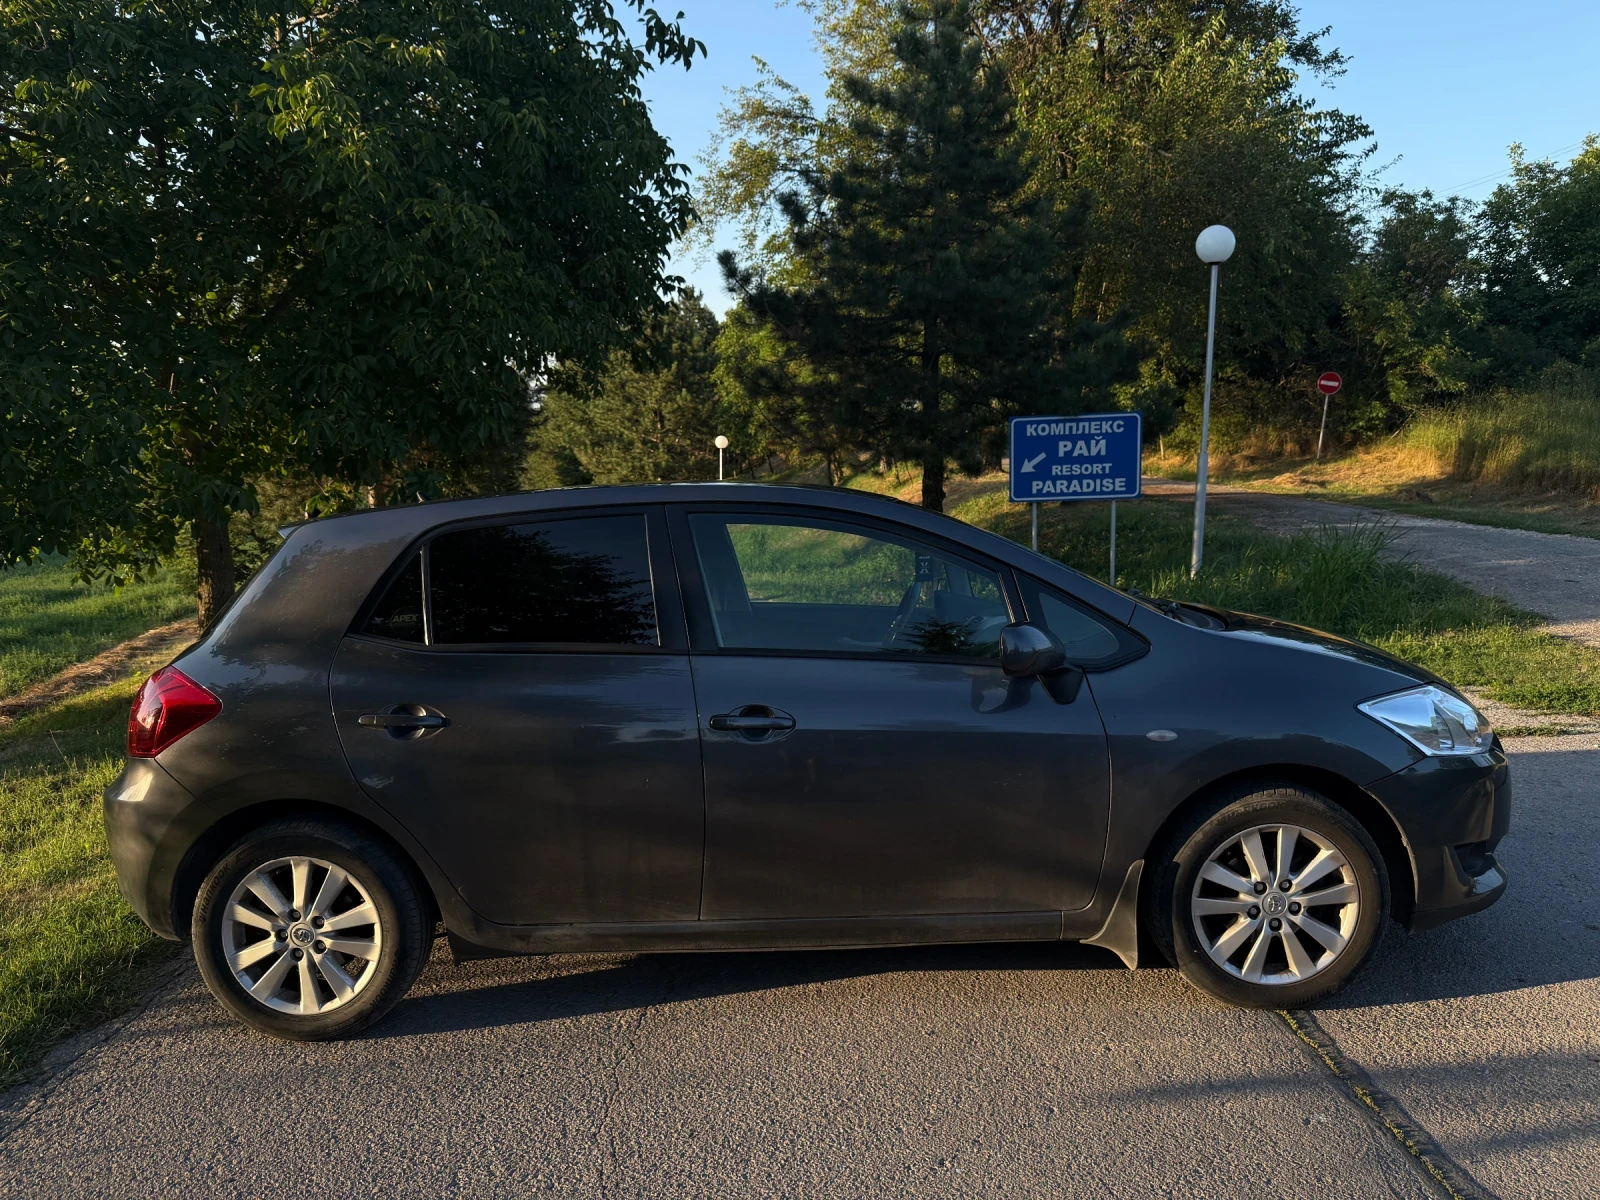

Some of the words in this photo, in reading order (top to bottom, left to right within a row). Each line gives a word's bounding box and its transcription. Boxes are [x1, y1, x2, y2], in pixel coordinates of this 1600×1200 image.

[1026, 420, 1125, 436] КОМПЛЕКС
[1058, 435, 1107, 457] РАЙ
[1051, 463, 1113, 476] RESORT
[1032, 477, 1127, 494] PARADISE
[392, 614, 418, 622] APEX
